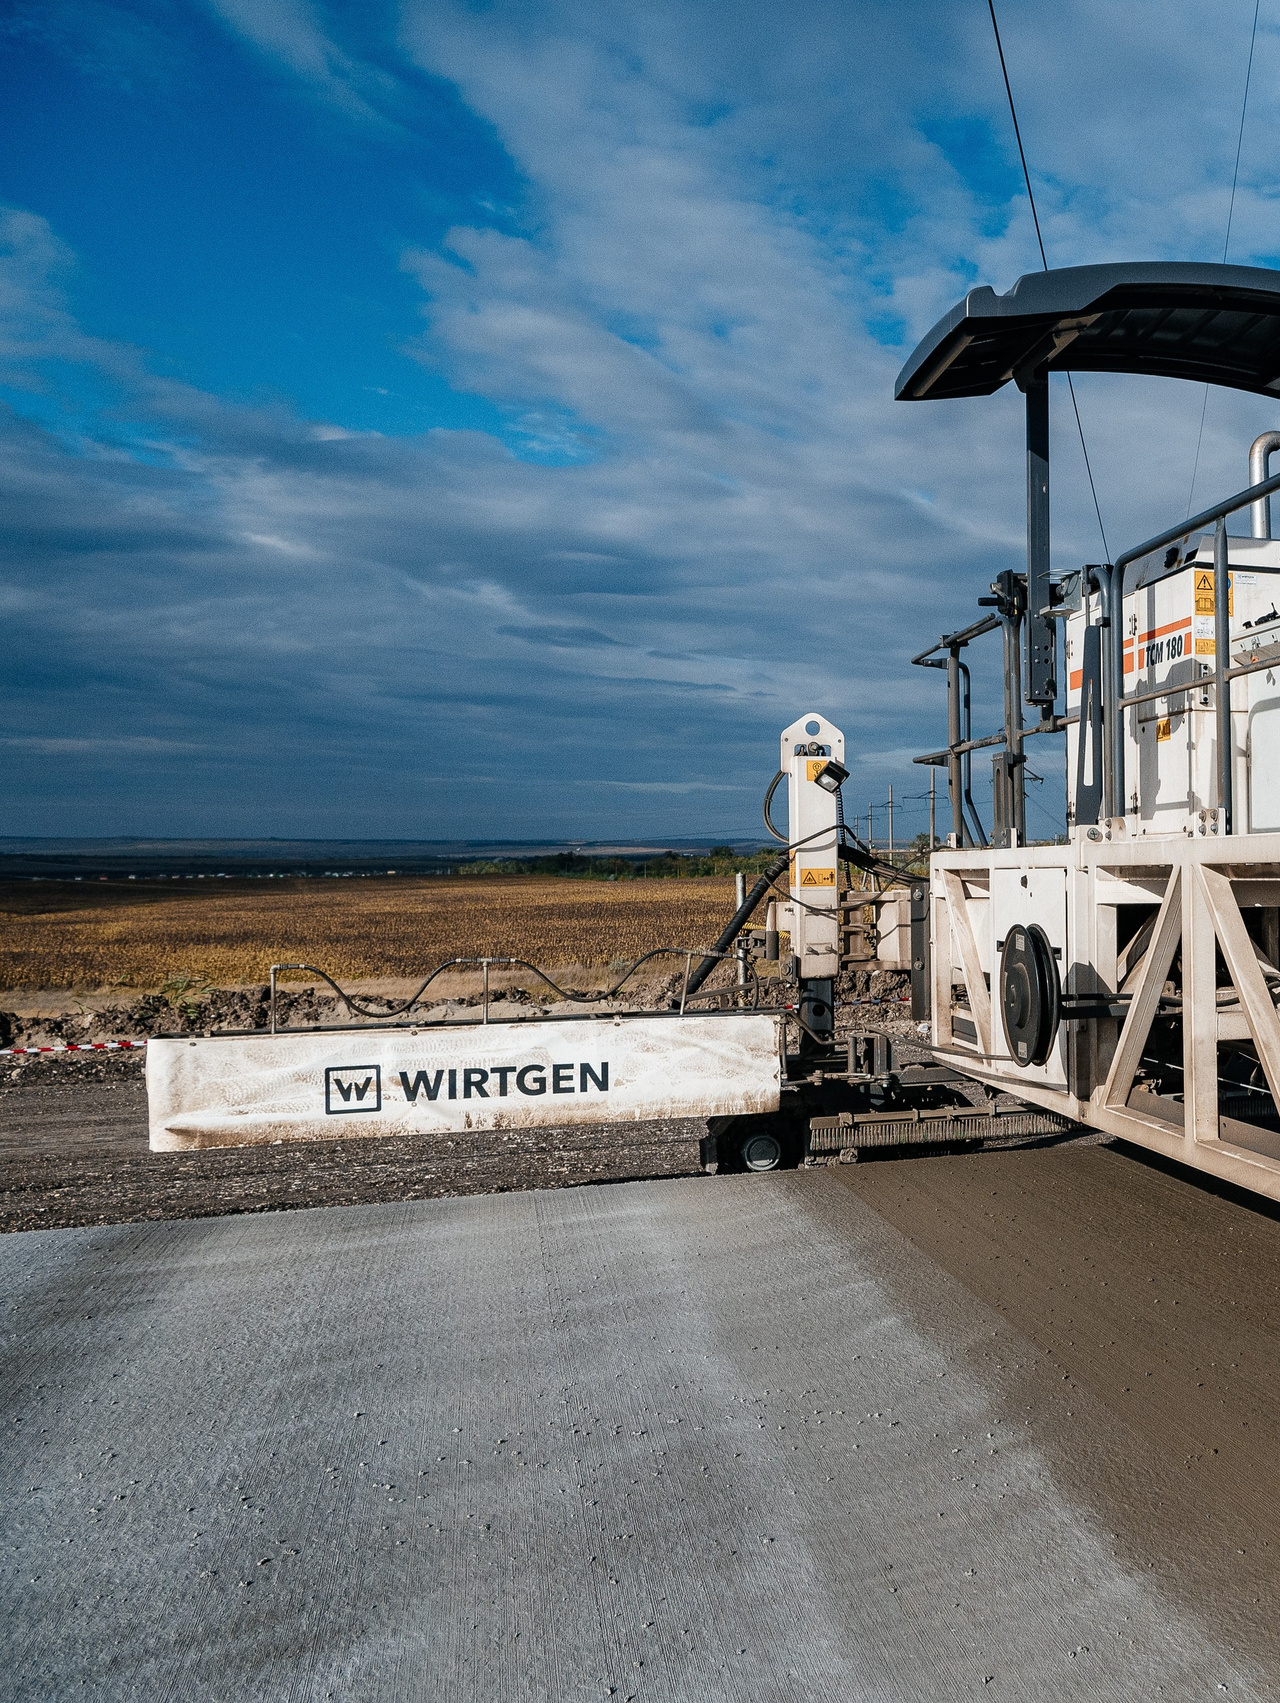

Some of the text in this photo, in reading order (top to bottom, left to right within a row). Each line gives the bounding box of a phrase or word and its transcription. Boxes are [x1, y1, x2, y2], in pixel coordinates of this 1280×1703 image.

[1146, 635, 1182, 667] TCM 180
[399, 1062, 609, 1102] WIRTGEN
